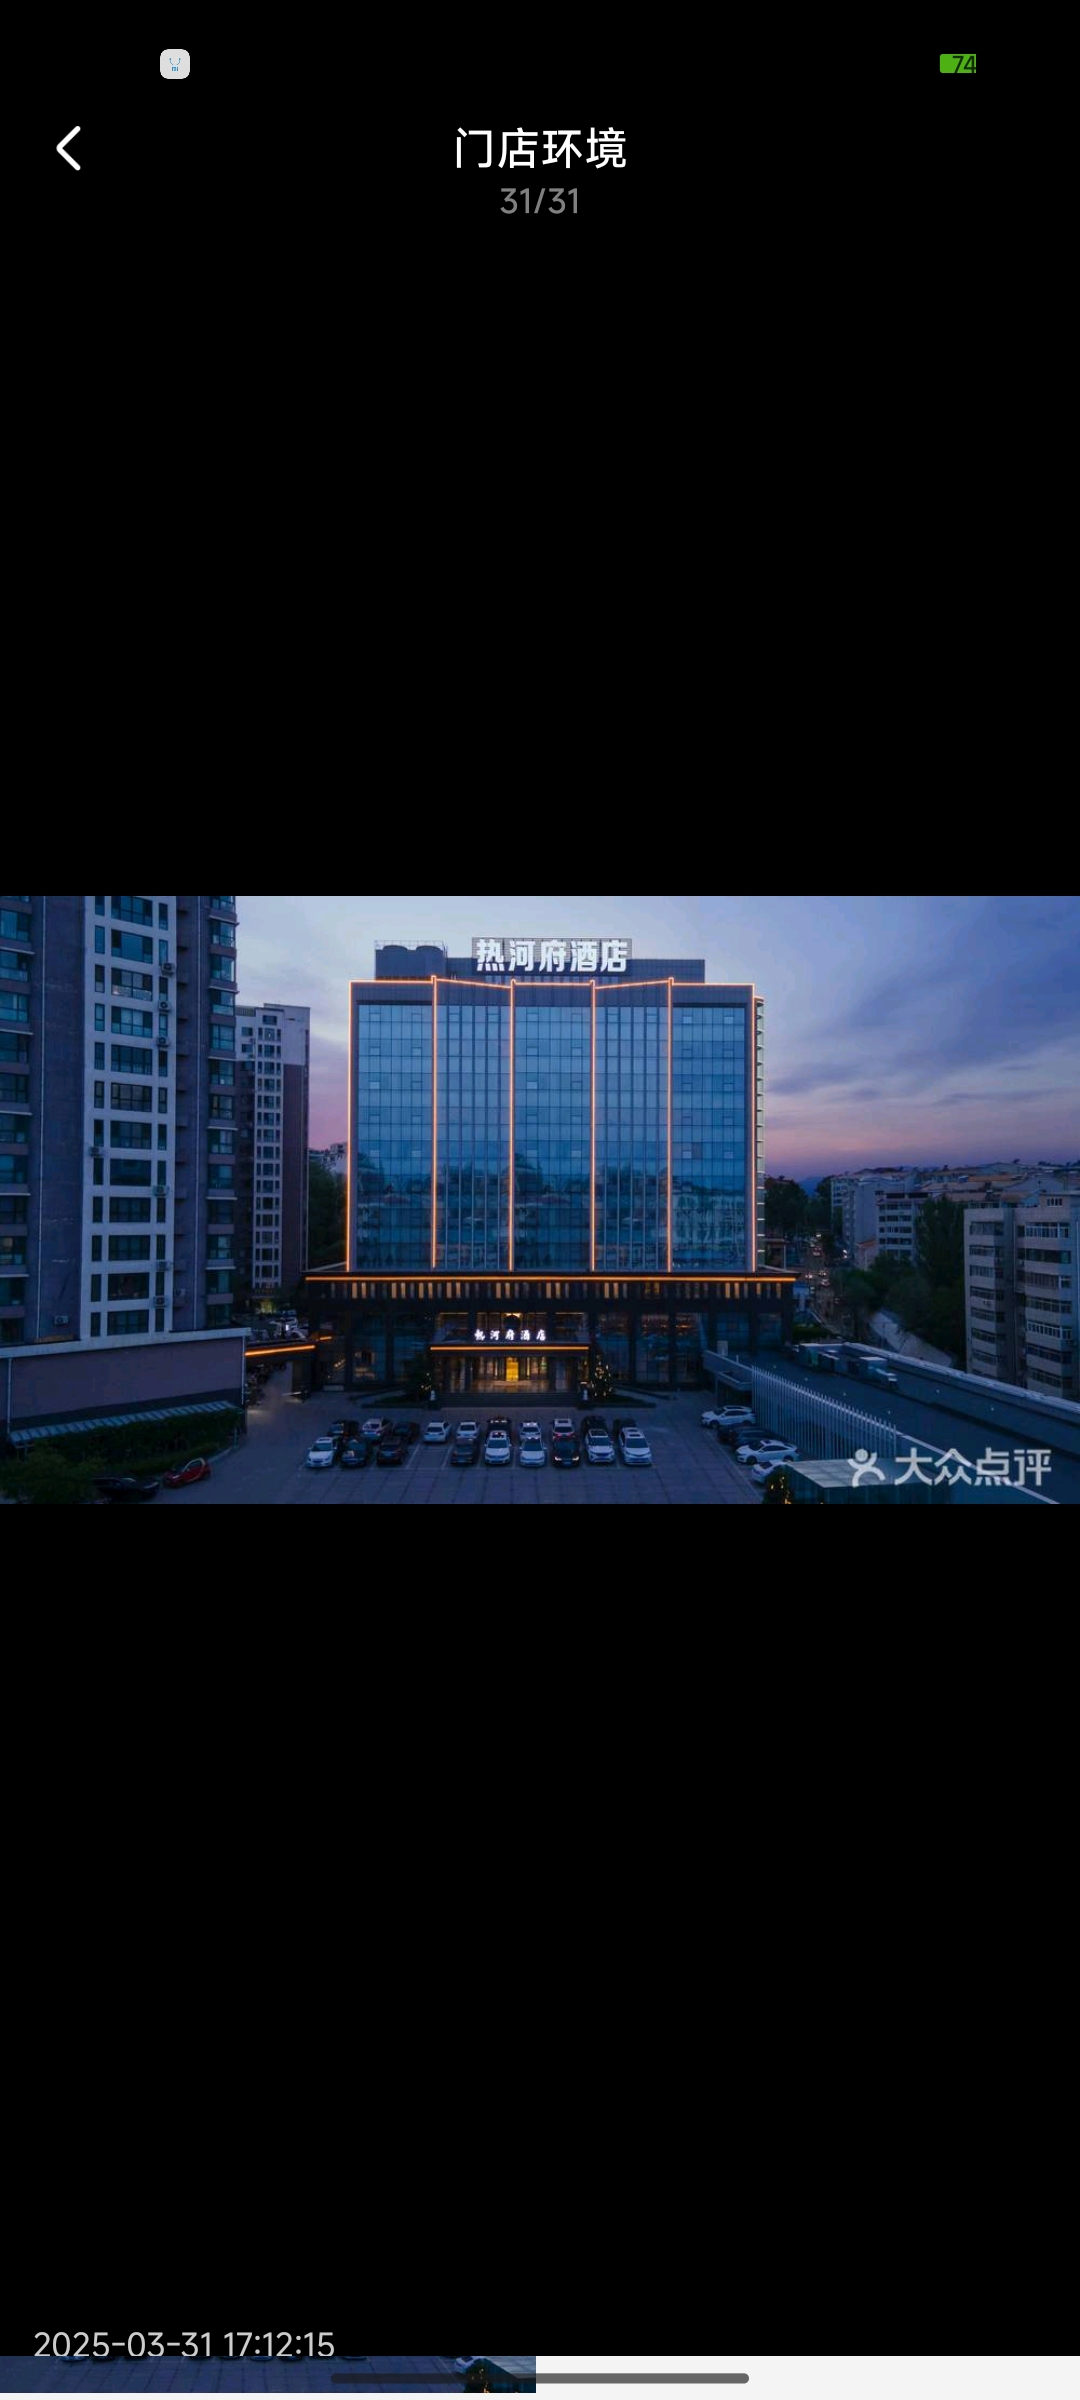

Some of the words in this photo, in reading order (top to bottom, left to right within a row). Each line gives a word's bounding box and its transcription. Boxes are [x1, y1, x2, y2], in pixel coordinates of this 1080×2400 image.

[952, 55, 976, 73] 74
[455, 126, 628, 170] 门店环境
[500, 187, 579, 215] 31/31
[476, 938, 628, 972] 热河府酒店
[33, 2331, 212, 2356] 2025-03-31
[223, 2331, 336, 2356] 17:12:15
